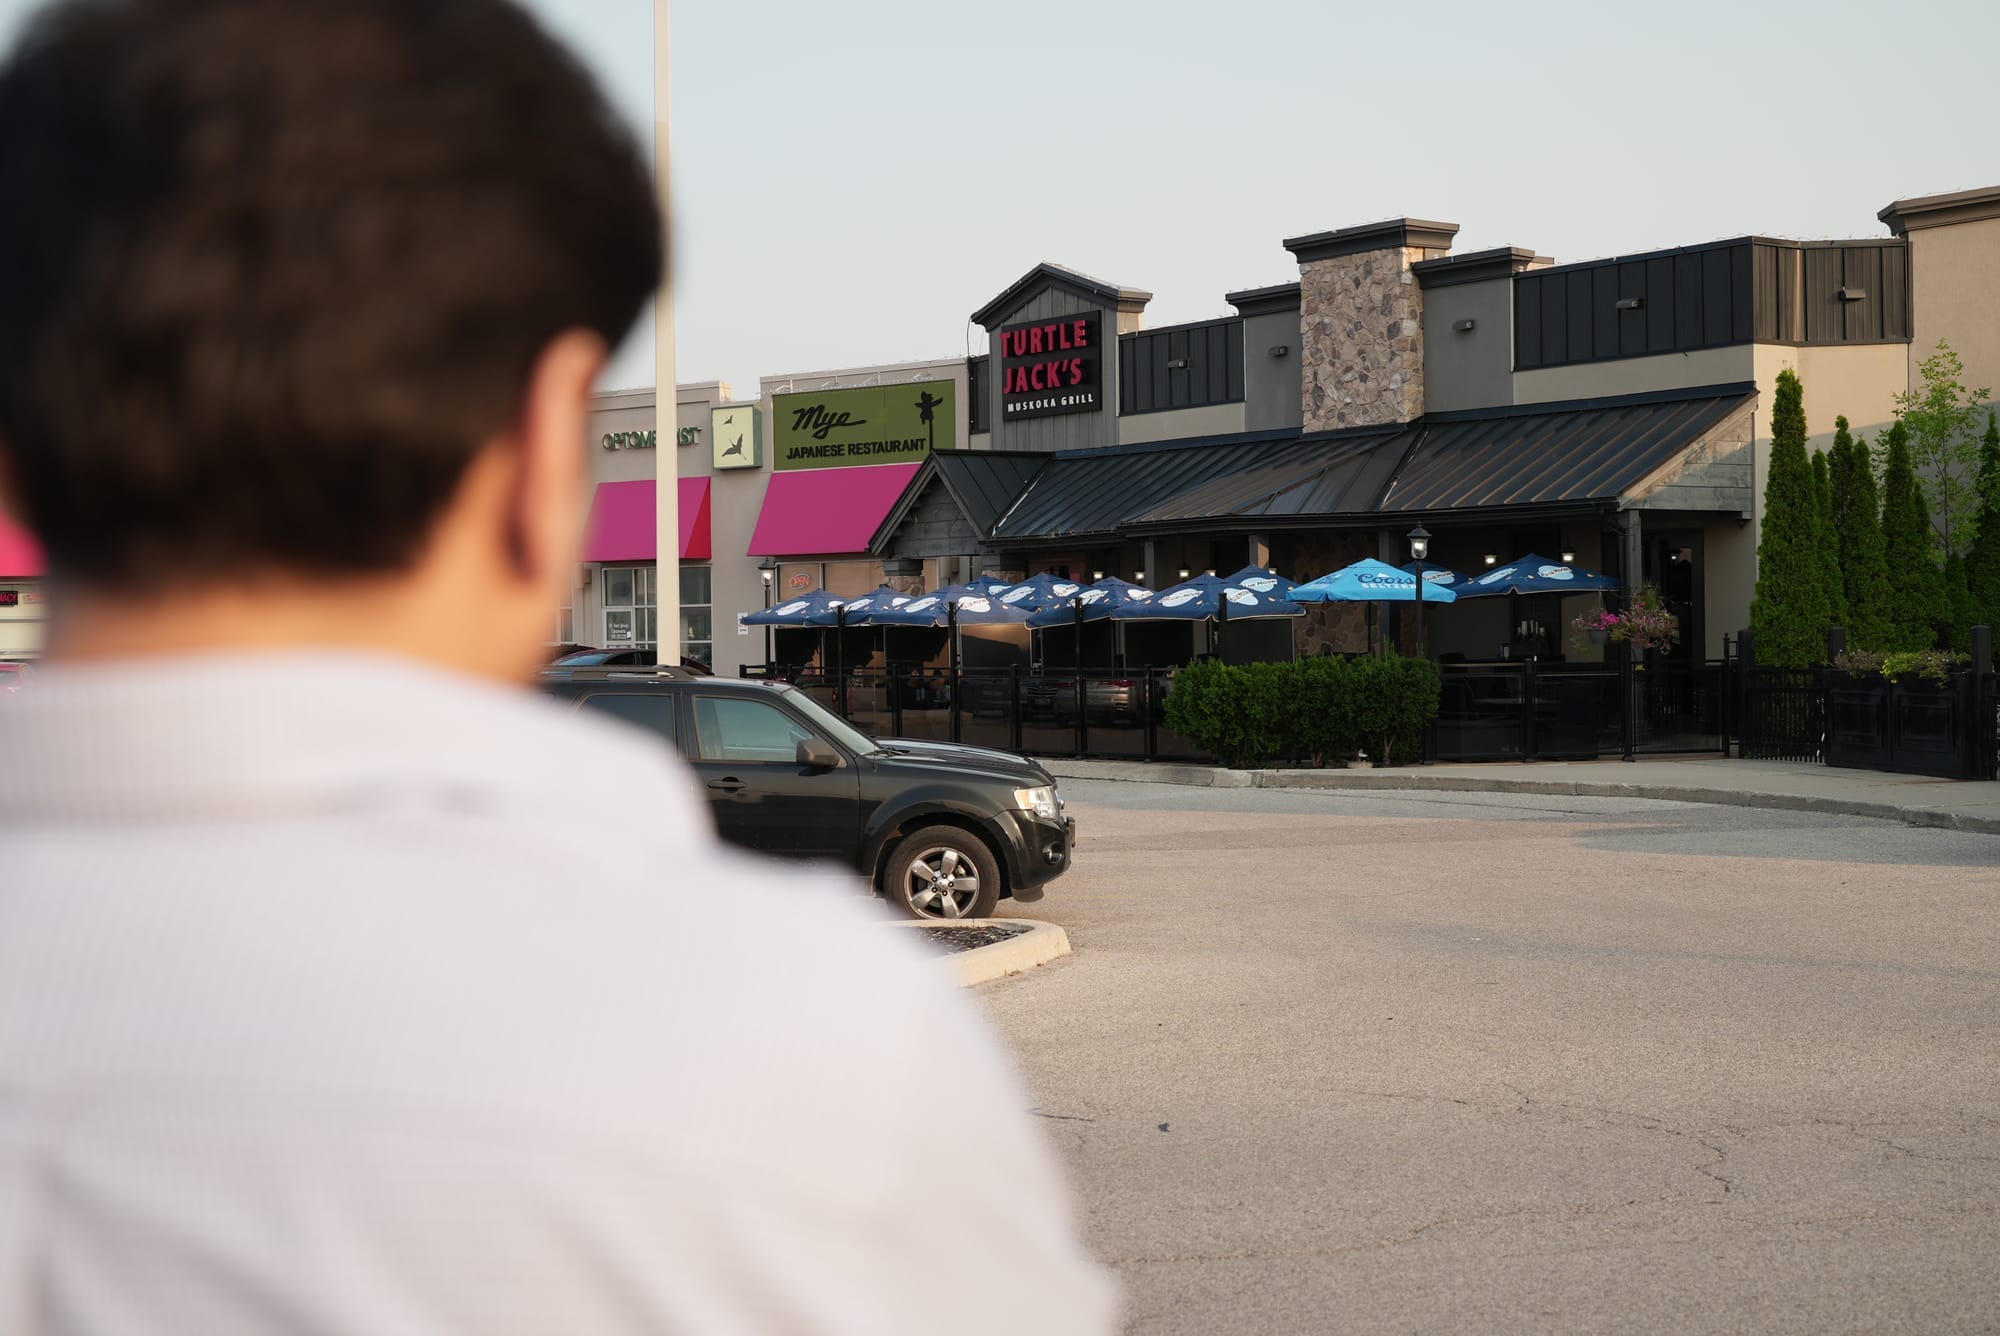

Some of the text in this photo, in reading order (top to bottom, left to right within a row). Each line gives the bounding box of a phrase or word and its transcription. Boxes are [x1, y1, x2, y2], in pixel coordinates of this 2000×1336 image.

[1000, 319, 1087, 358] TURTLE
[1004, 358, 1082, 393] JACK'S
[1007, 393, 1093, 412] MUSKOKA GRILL
[791, 404, 867, 439] Mye
[786, 438, 926, 460] JAPANESE RESTAURANT
[789, 576, 810, 587] OPEN
[1356, 573, 1415, 584] Coors
